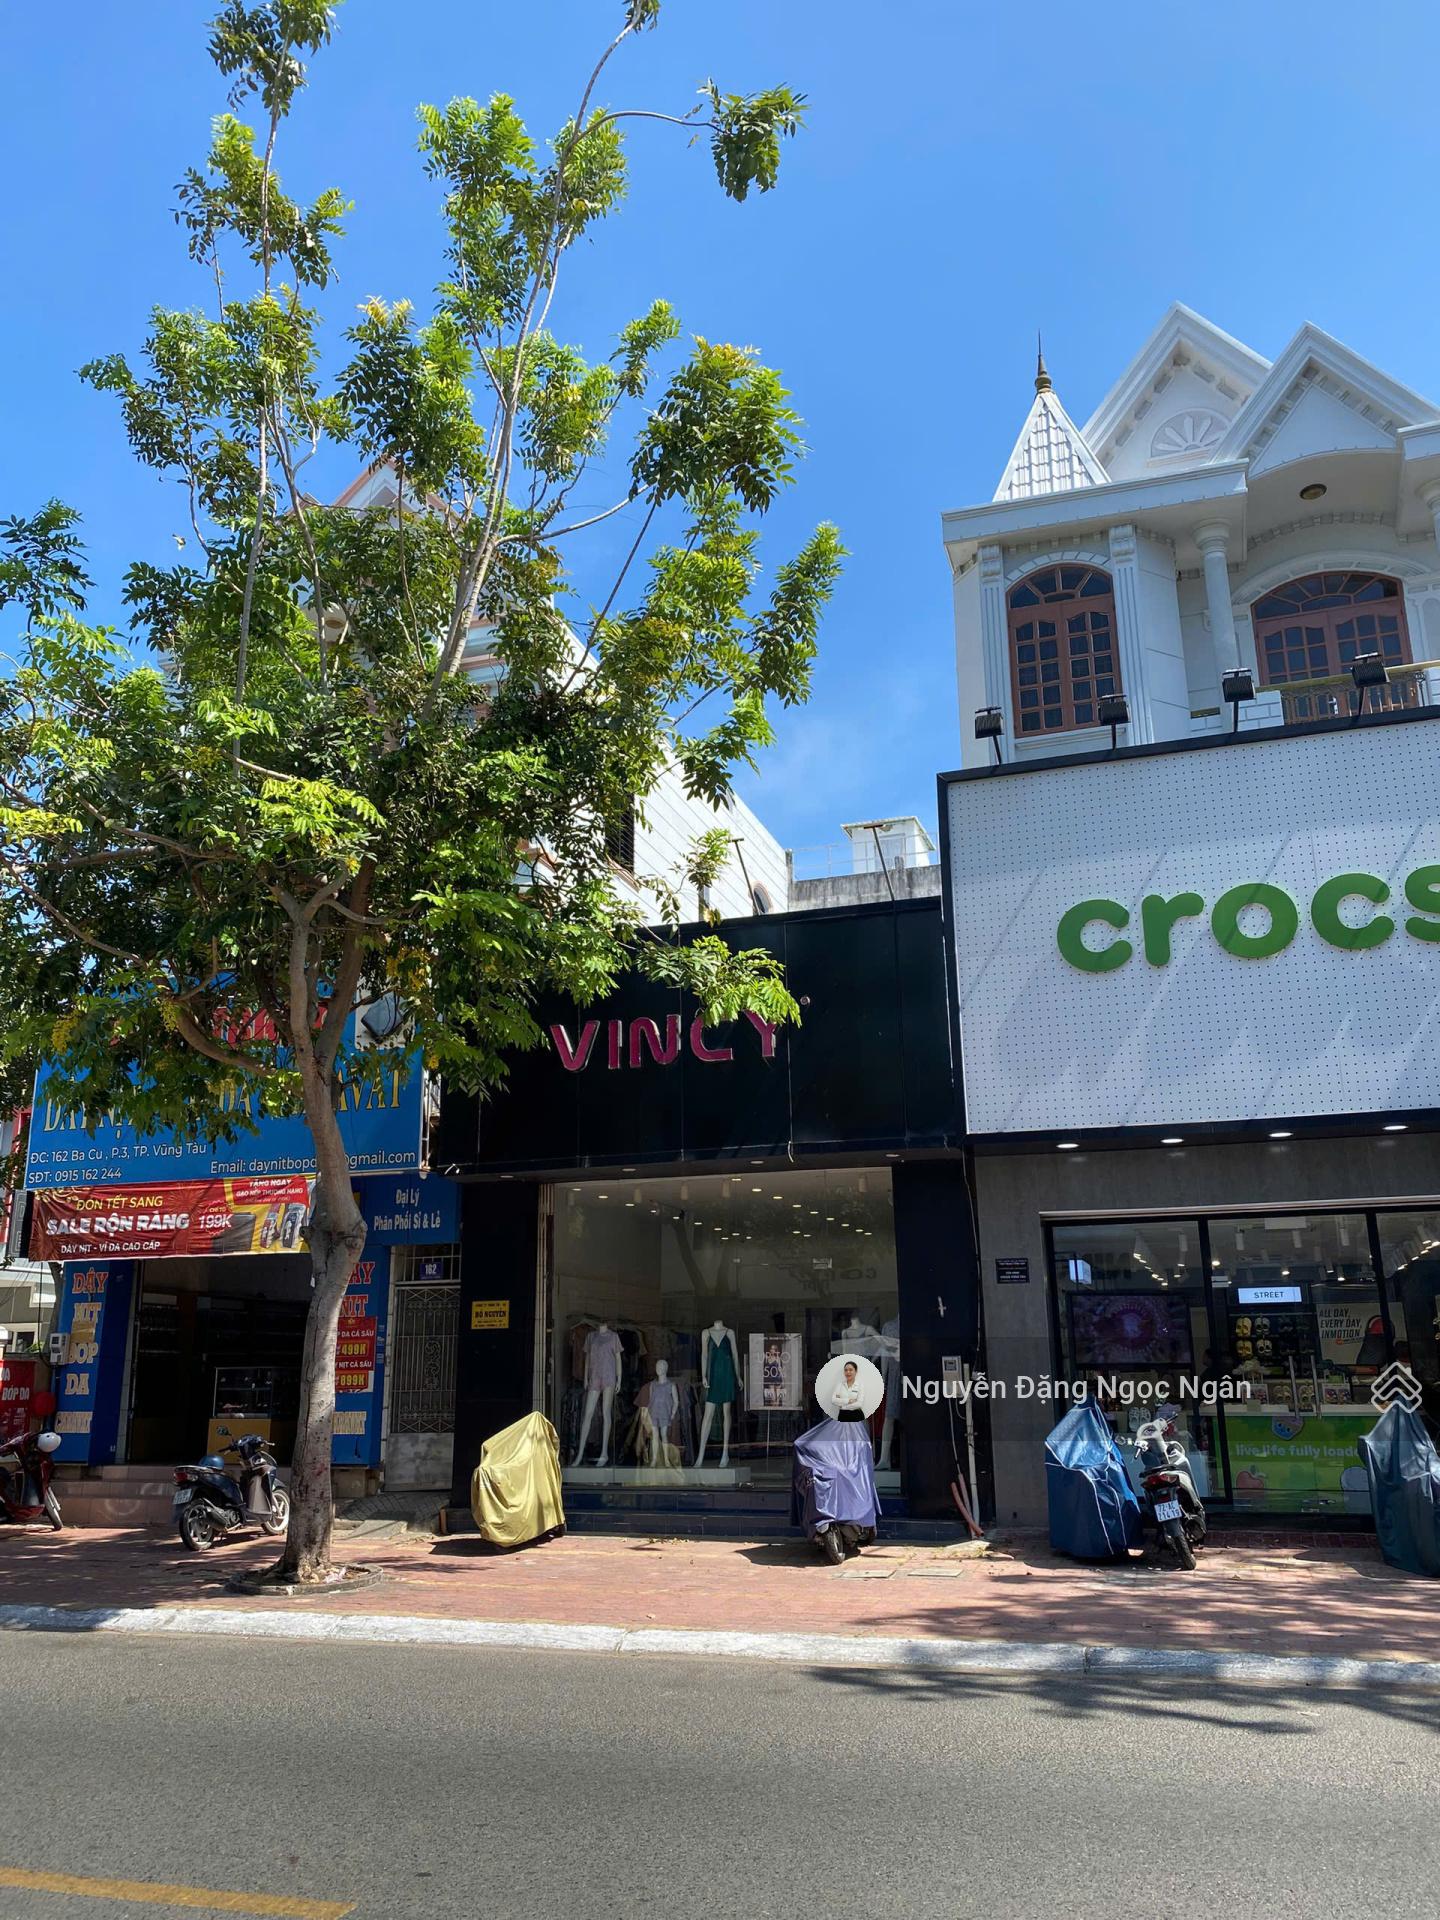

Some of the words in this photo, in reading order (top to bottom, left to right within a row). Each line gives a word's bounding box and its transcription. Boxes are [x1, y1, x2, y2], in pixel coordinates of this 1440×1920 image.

[550, 1007, 777, 1073] VINCY
[30, 1152, 49, 1164] ĐC:
[52, 1151, 68, 1163] 162
[71, 1150, 84, 1162] Ba
[88, 1148, 103, 1160] Cu
[111, 1147, 130, 1160] P.3,
[133, 1145, 150, 1158] TP.
[153, 1144, 183, 1158] Vũng
[186, 1142, 207, 1154] Tàu
[211, 1159, 246, 1174] Email:
[28, 1171, 52, 1184] SĐT:
[55, 1170, 79, 1182] 0915
[82, 1168, 98, 1180] 162
[101, 1167, 122, 1179] 244
[106, 1193, 127, 1210] TẾT
[129, 1196, 163, 1208] SANG
[396, 1188, 409, 1208] Đại
[410, 1188, 420, 1207] Lý
[46, 1216, 92, 1235] SALE
[198, 1213, 234, 1229] 199K
[422, 1213, 429, 1228] &
[122, 1241, 141, 1251] CAO
[425, 1263, 437, 1275] 162
[1254, 1291, 1284, 1299] STREET
[1319, 1308, 1332, 1318] ALL
[1320, 1319, 1344, 1328] EVERY
[65, 1373, 90, 1395] DA
[1289, 1444, 1320, 1459] fully
